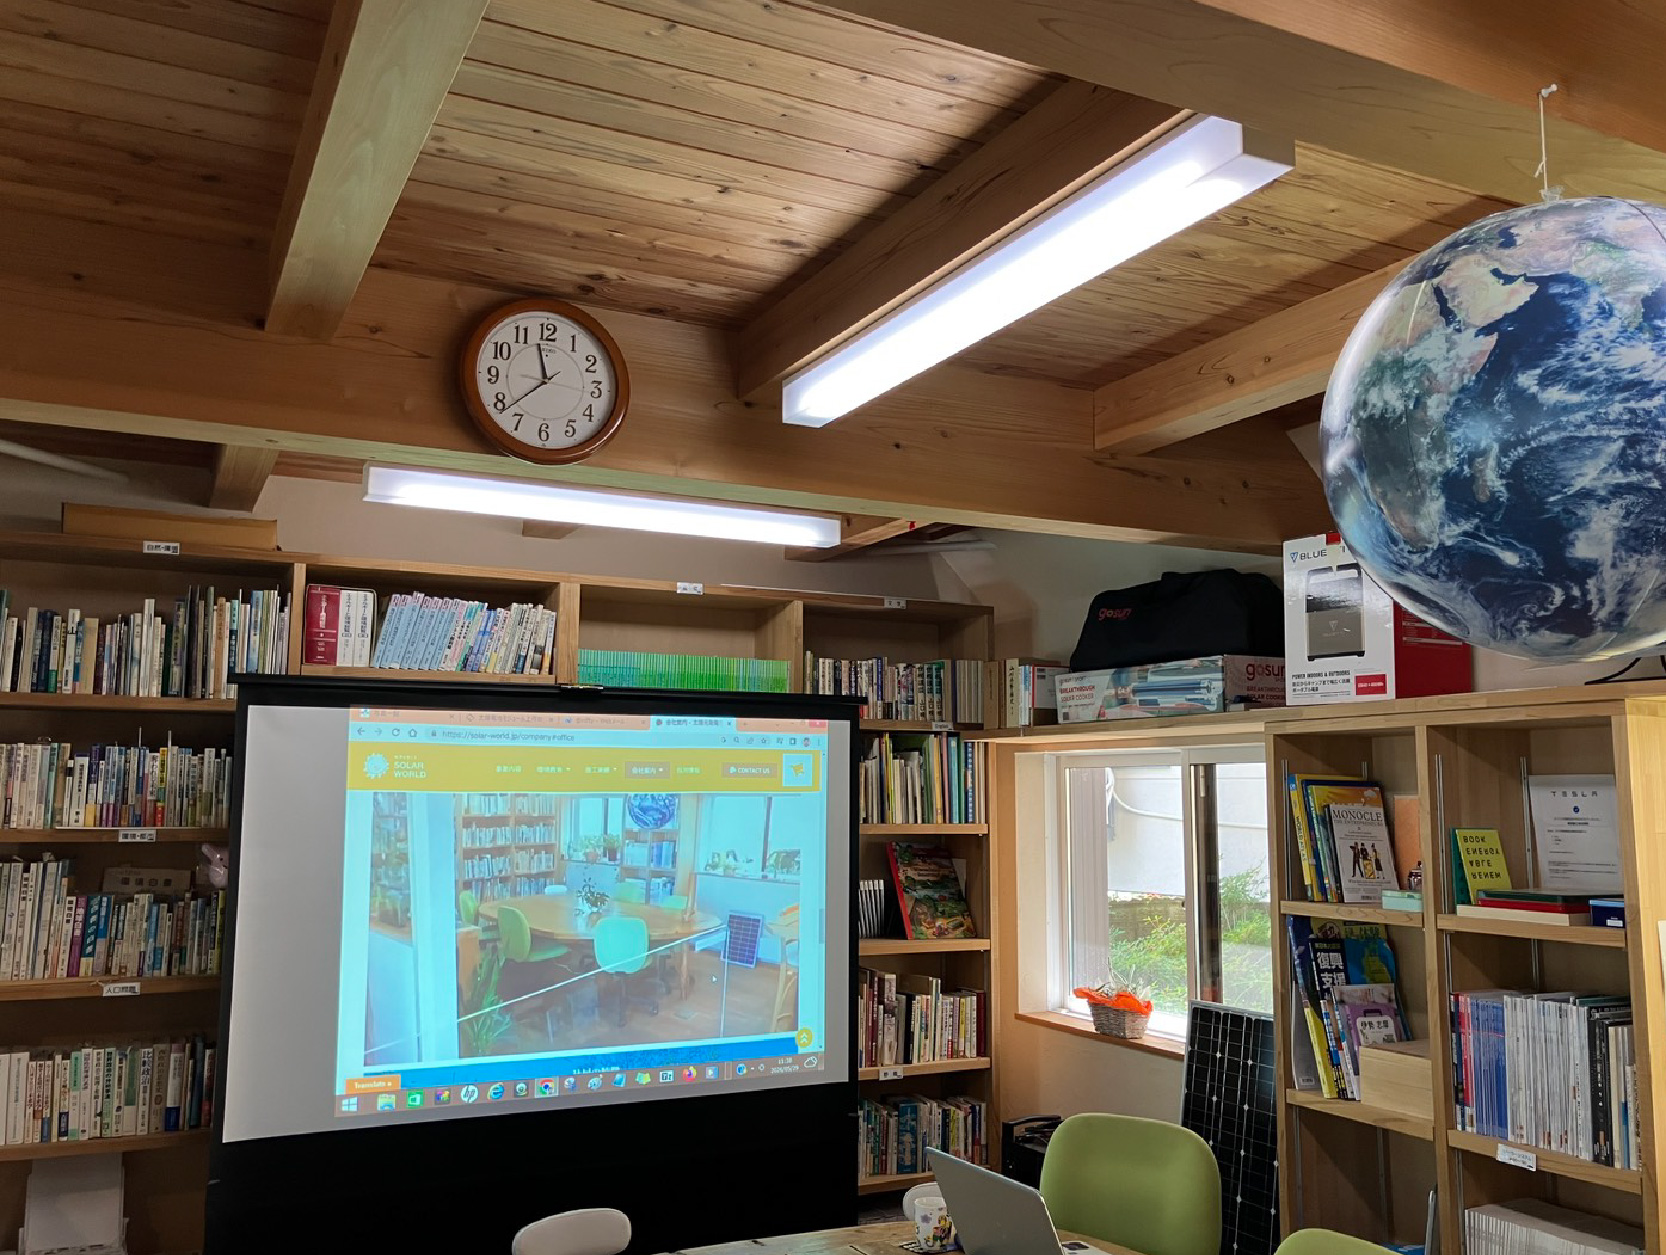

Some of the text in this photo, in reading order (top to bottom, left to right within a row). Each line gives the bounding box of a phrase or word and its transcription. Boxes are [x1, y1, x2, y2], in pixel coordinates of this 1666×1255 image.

[514, 325, 529, 344] 11
[539, 323, 558, 342] 12
[492, 341, 511, 361] 10
[570, 334, 577, 353] 1
[585, 354, 598, 373] 2
[487, 365, 500, 385] 9
[590, 380, 603, 399] 3
[493, 392, 506, 412] 8
[511, 413, 524, 431] 7
[582, 404, 594, 422] 4
[538, 423, 550, 442] 6
[564, 419, 577, 437] 5
[394, 761, 425, 770] SOLAR
[394, 770, 427, 779] WORLD
[1550, 790, 1598, 798] TESLA
[1332, 808, 1384, 823] MONOCLE
[1316, 951, 1345, 970] 復興
